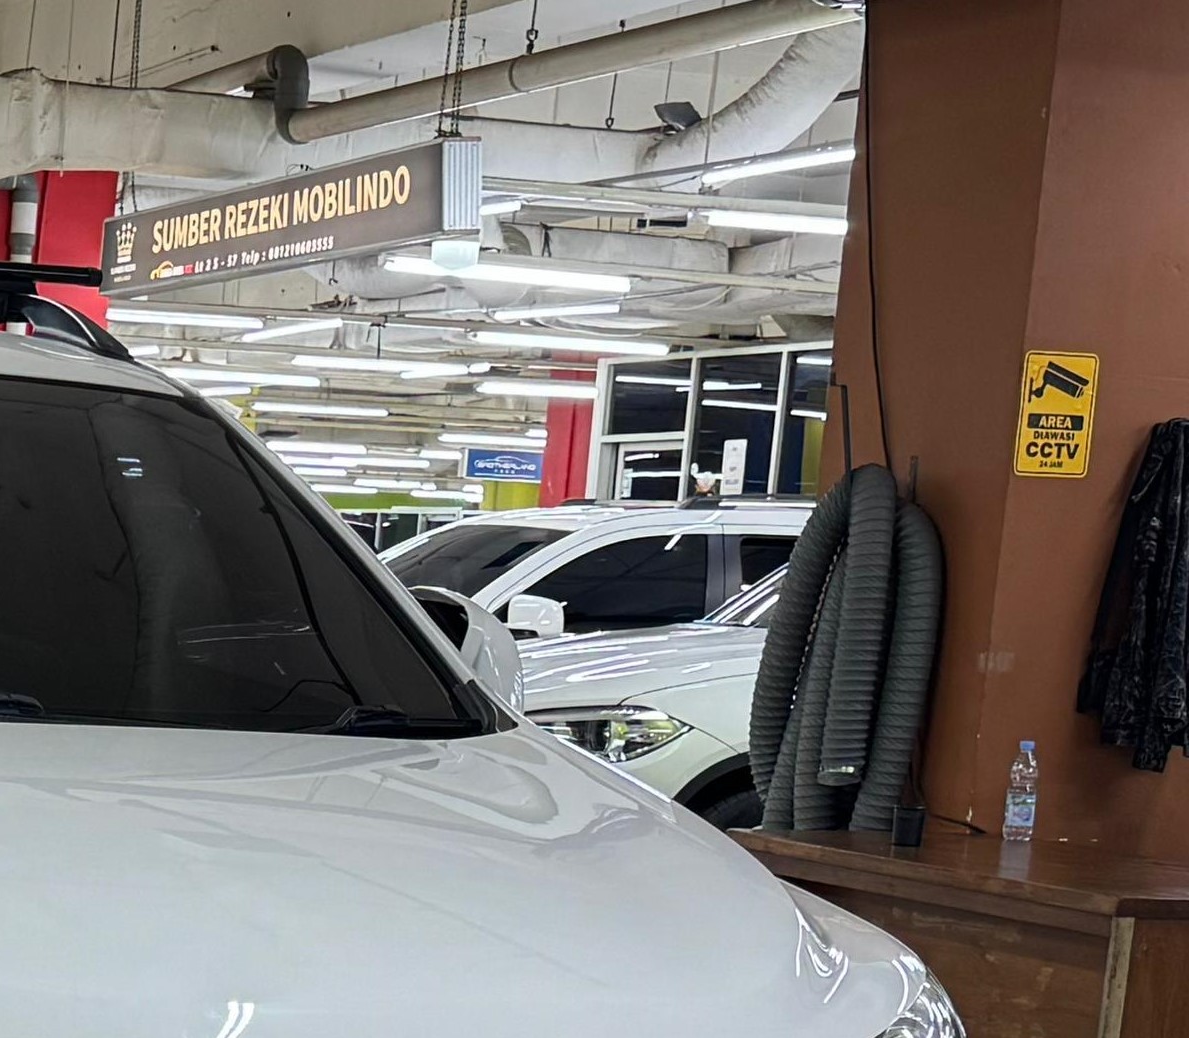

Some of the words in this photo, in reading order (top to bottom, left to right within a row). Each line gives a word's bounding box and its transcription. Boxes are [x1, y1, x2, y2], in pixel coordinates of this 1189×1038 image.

[152, 208, 221, 254] SUMBER
[224, 192, 289, 240] REZEKI
[293, 165, 411, 226] MOBILINDO
[1038, 415, 1072, 429] AREA
[1033, 430, 1075, 441] DIAWASI
[1025, 441, 1080, 460] CCTV
